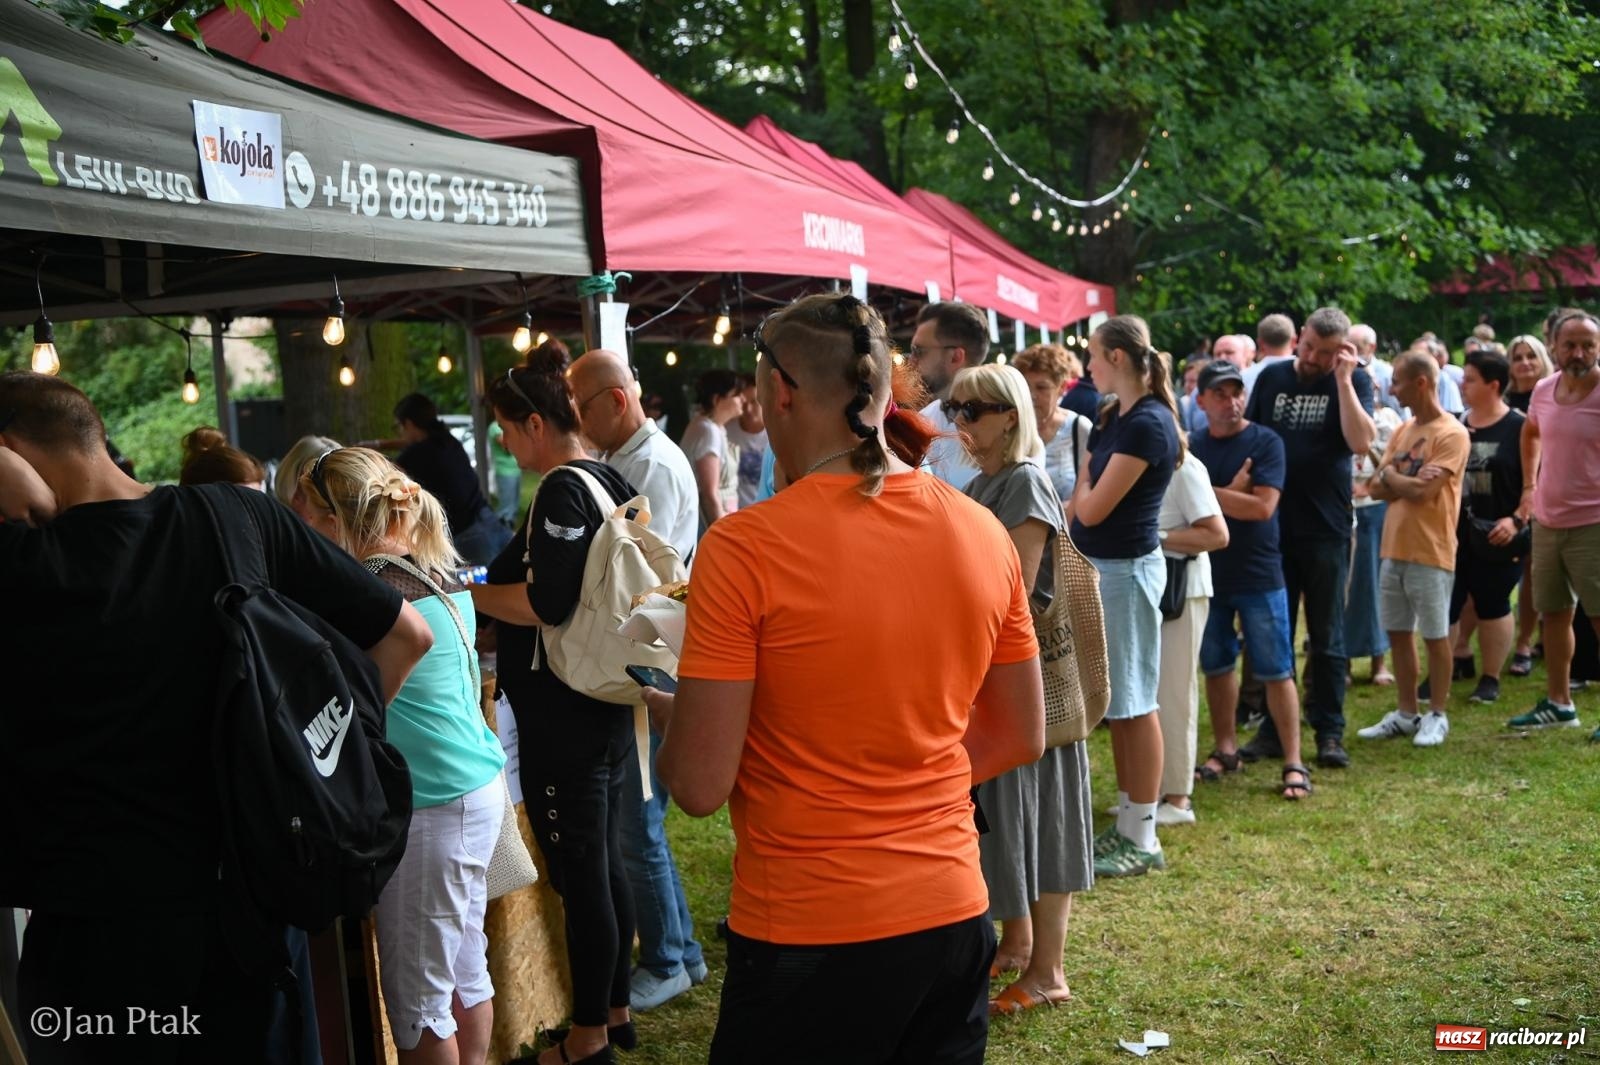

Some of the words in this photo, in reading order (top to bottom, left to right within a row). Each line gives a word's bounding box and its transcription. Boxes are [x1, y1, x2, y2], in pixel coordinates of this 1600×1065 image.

[219, 126, 274, 177] kojola
[322, 160, 380, 217] +48
[387, 168, 445, 222] 886
[449, 176, 500, 225] 945
[503, 182, 547, 227] 340
[1040, 624, 1073, 650] RADA
[303, 696, 348, 756] NIKE
